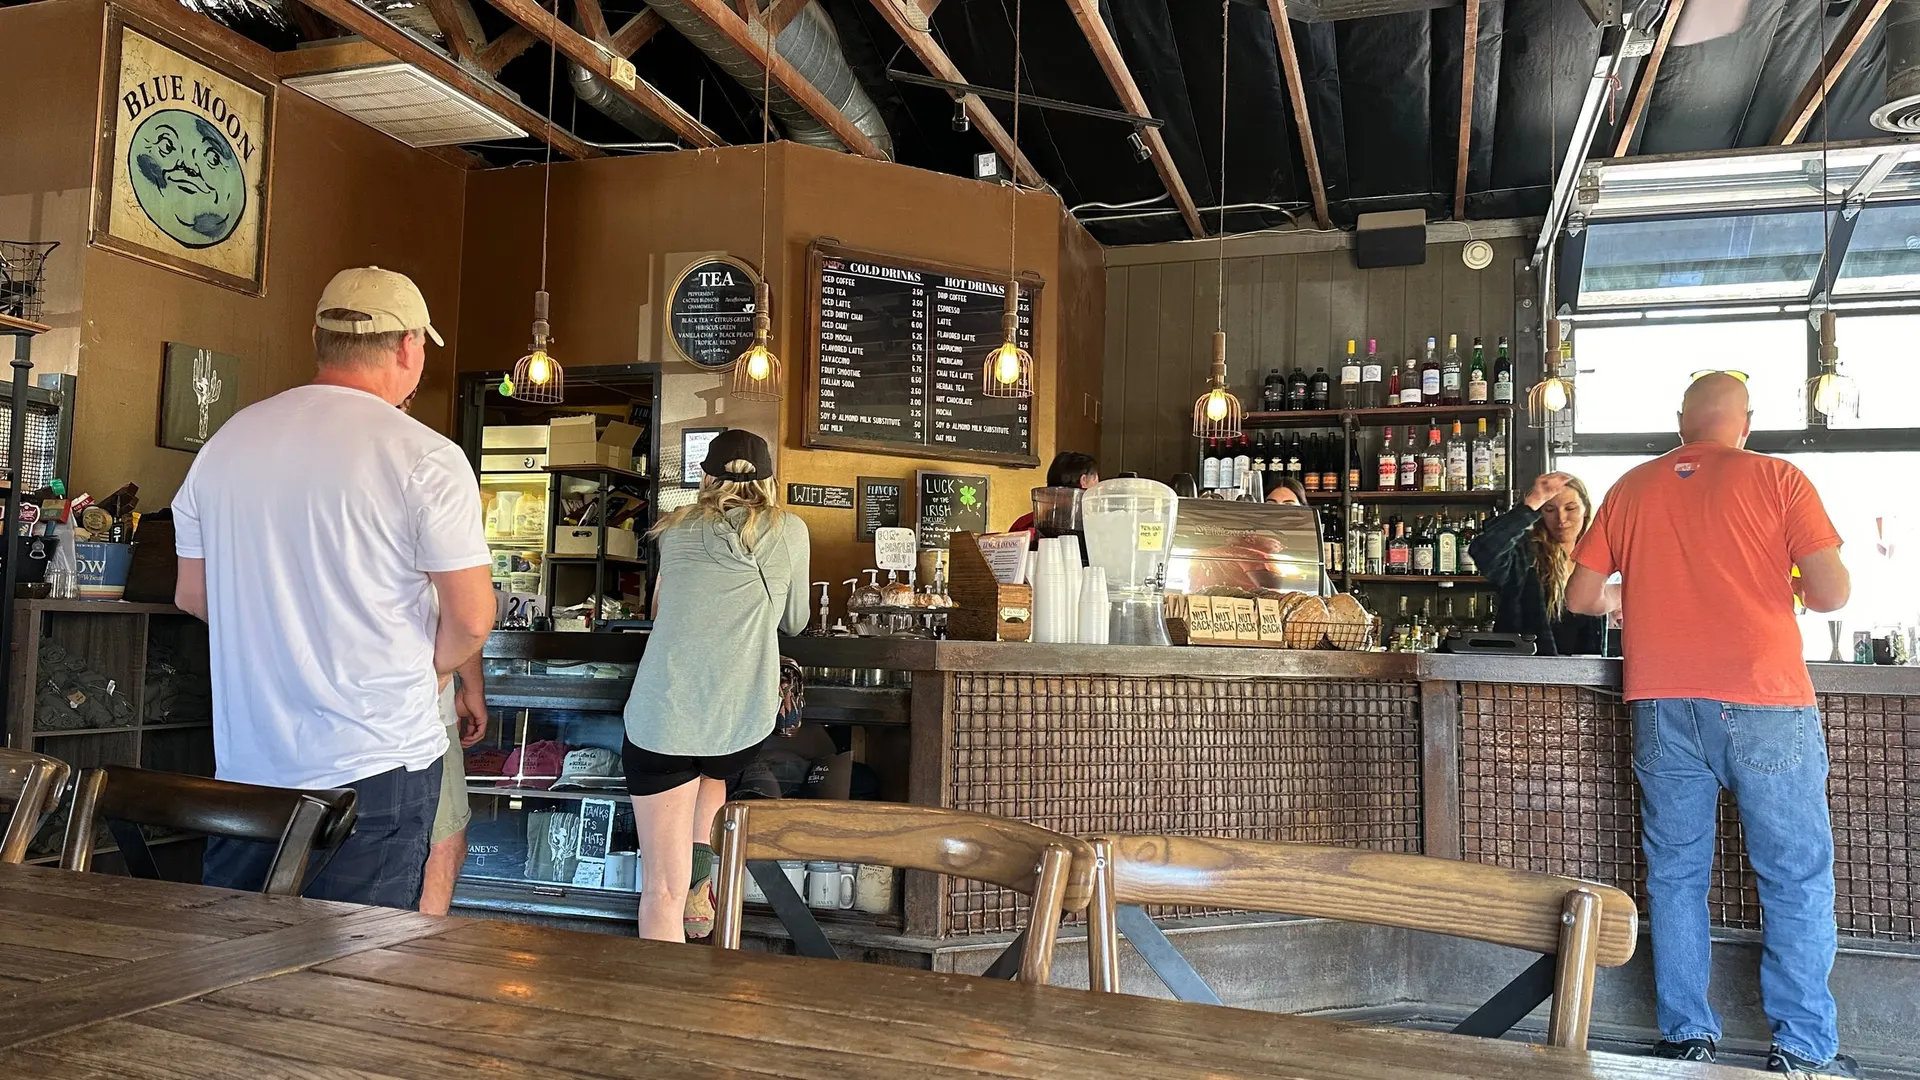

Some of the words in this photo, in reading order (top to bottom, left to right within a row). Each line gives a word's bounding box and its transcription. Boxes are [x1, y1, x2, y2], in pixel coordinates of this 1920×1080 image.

[123, 75, 185, 122] BLUE
[192, 80, 256, 163] MOON
[850, 263, 879, 276] COLD
[882, 267, 921, 282] DRINKS
[699, 272, 735, 286] TEA
[823, 275, 834, 283] ICED
[836, 277, 855, 286] COFFEE
[945, 277, 966, 287] HOT
[968, 280, 1005, 294] DRINKS
[823, 287, 834, 295] ICED
[836, 288, 846, 296] TEA
[938, 292, 948, 300] DRIP
[949, 293, 967, 303] COFFEE
[822, 298, 834, 306] ICED
[835, 300, 851, 309] LATTE
[822, 309, 834, 317] ICED
[835, 311, 849, 320] DIRTY
[851, 313, 863, 321] CHAI
[937, 305, 960, 314] ESPRESSO
[822, 321, 834, 329] ICED
[835, 322, 848, 330] CHAI
[937, 318, 951, 326] LATTE
[822, 332, 834, 340] ICED
[835, 334, 853, 343] MOCHA
[937, 330, 960, 340] FLAVORED
[961, 334, 976, 342] LATTE
[822, 344, 847, 354] FLAVORED
[848, 347, 864, 355] LATTE
[821, 355, 851, 365] JAVACCINO
[937, 357, 963, 366] AMERICANO
[821, 366, 835, 375] FRUIT
[837, 368, 861, 378] SMOOTHIE
[936, 369, 948, 377] CHAI
[949, 371, 959, 379] TEA
[959, 372, 974, 380] LATTE
[821, 378, 840, 387] ITALIAN
[842, 380, 855, 388] SODA
[936, 382, 954, 391] HERBAL
[955, 384, 965, 392] TEA
[821, 389, 834, 397] SODA
[820, 401, 835, 409] JUICE
[936, 395, 945, 403] HOT
[946, 397, 973, 406] CHOCOLATE
[936, 408, 952, 417] MOCHA
[820, 412, 830, 420] SOY
[838, 414, 858, 422] ALMOND
[860, 416, 872, 424] MILK
[873, 417, 901, 427] SUBSTITUTE
[820, 423, 829, 431] OAT
[952, 423, 971, 431] ALMOND
[983, 426, 1009, 435] SUBSTITUTE
[867, 485, 898, 496] FLAVORS
[926, 479, 955, 494] LUCK
[793, 485, 823, 504] WIFI
[925, 505, 952, 516] IRISH
[113, 526, 121, 542] ST
[1192, 610, 1208, 621] NUT
[1214, 611, 1230, 622] NUT
[1237, 613, 1252, 623] NUT
[1262, 614, 1277, 624] NUT
[1191, 620, 1212, 631] SACK
[1214, 621, 1235, 632] SACK
[1237, 622, 1257, 633] SACK
[1261, 623, 1281, 634] SACK
[584, 806, 610, 821] TANKS
